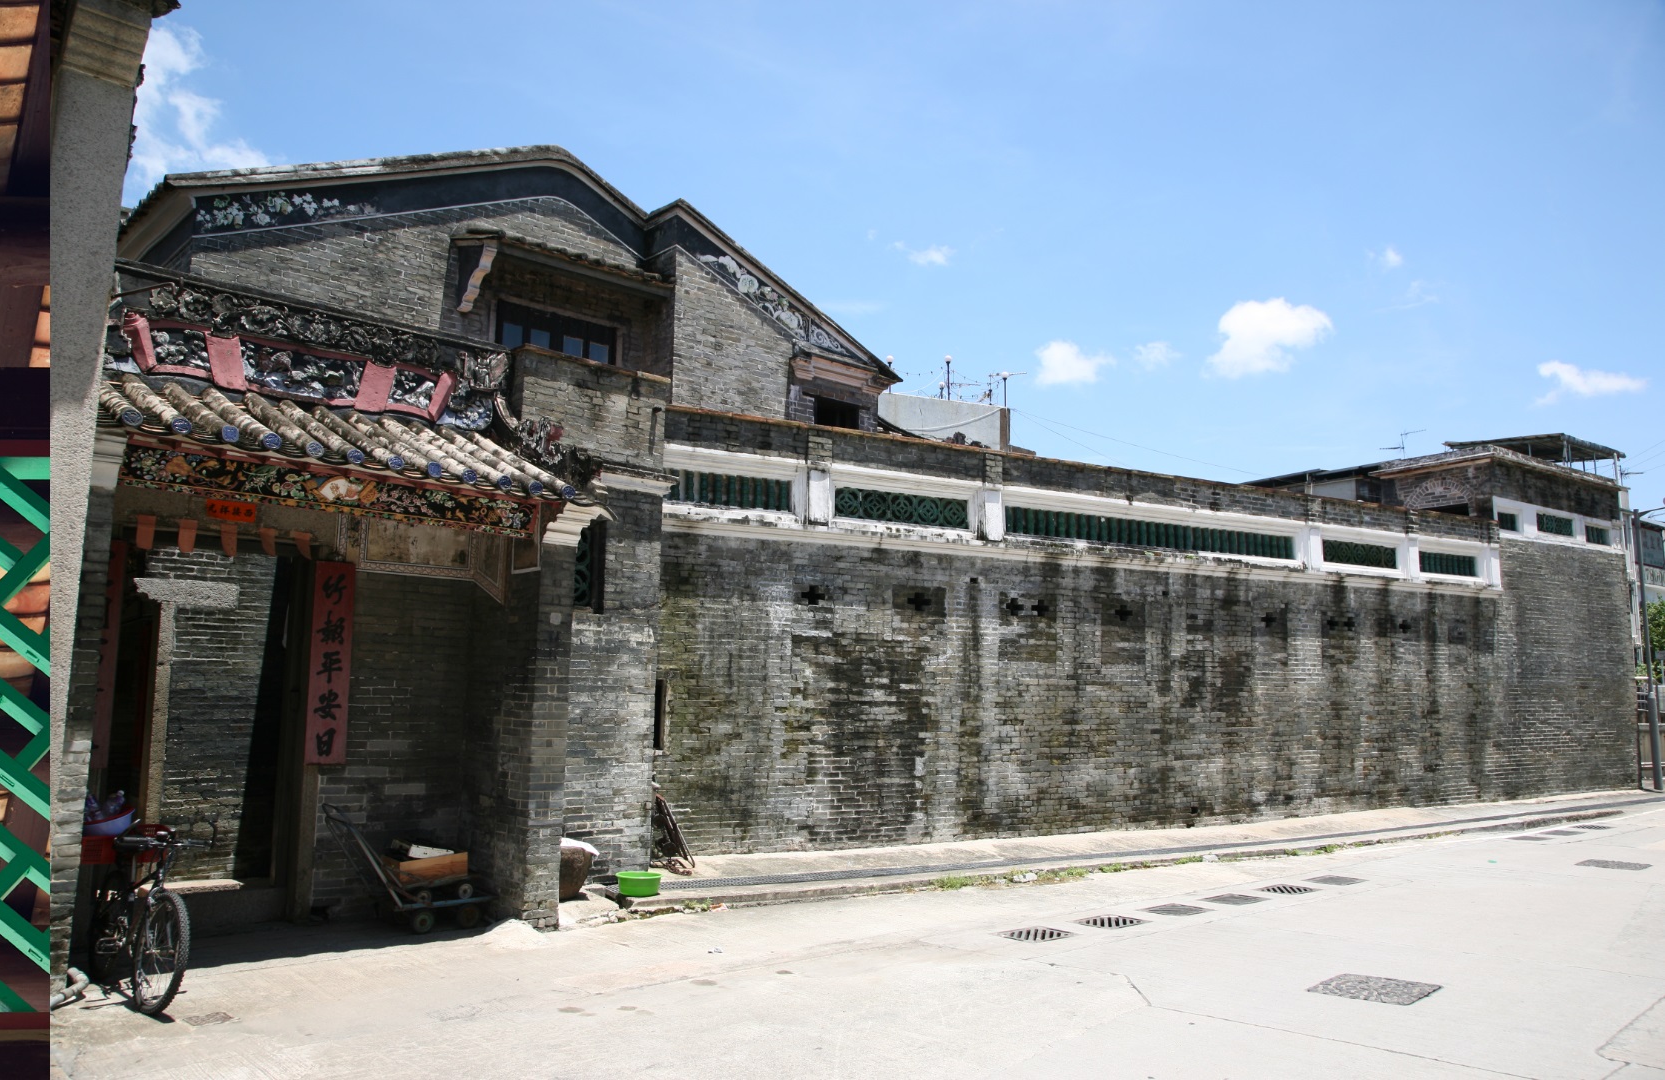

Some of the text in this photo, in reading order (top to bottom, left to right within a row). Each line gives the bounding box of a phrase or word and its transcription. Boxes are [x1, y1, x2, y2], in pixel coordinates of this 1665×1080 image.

[313, 573, 348, 757] 竹報平安日
